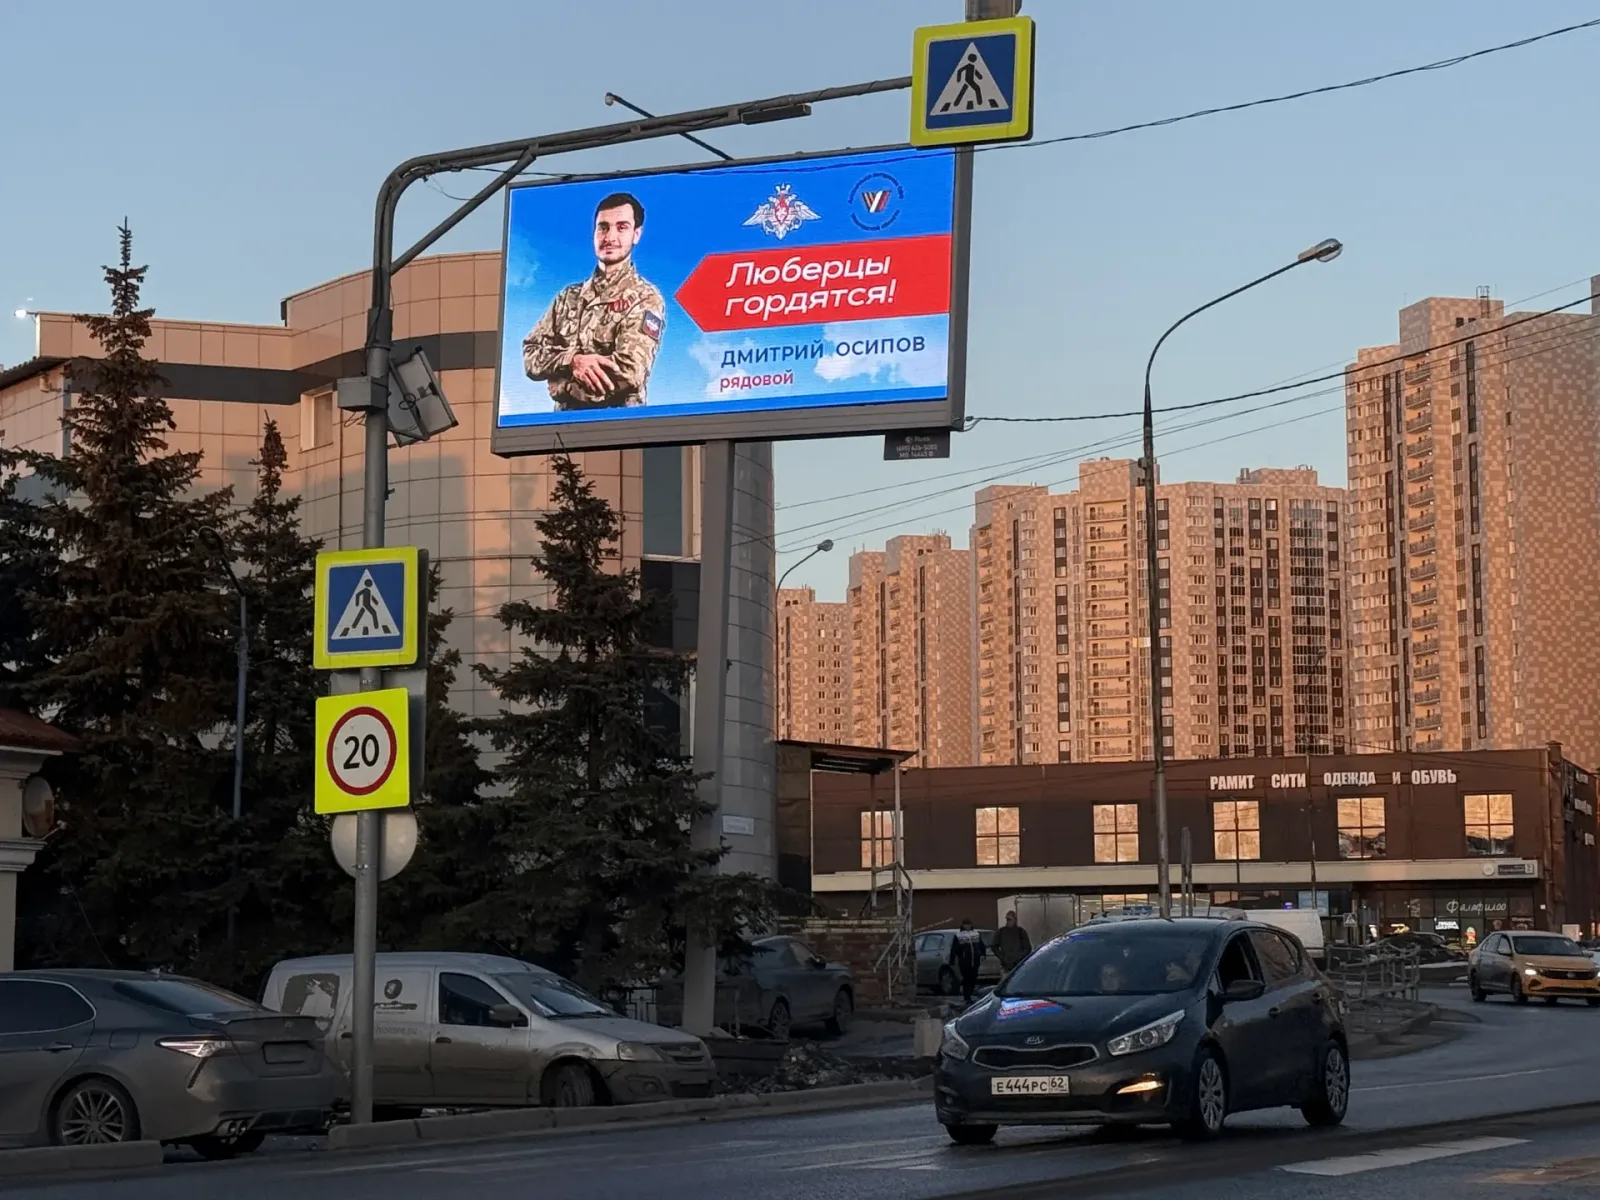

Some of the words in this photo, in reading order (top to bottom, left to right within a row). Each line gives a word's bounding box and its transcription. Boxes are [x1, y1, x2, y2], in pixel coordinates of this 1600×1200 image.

[725, 256, 891, 288] Люберцы
[724, 278, 898, 321] гордятся!
[721, 340, 824, 368] ДМИТРИЙ
[836, 336, 925, 356] ОСИПОВ
[720, 369, 794, 392] рядовой
[343, 733, 380, 770] 20
[1209, 774, 1255, 790] РАМИТ
[1271, 773, 1307, 788] СИТИ
[1323, 771, 1376, 787] ОДЕЖДА
[1411, 769, 1457, 785] ОБУВЬ
[1050, 1077, 1064, 1088] 62
